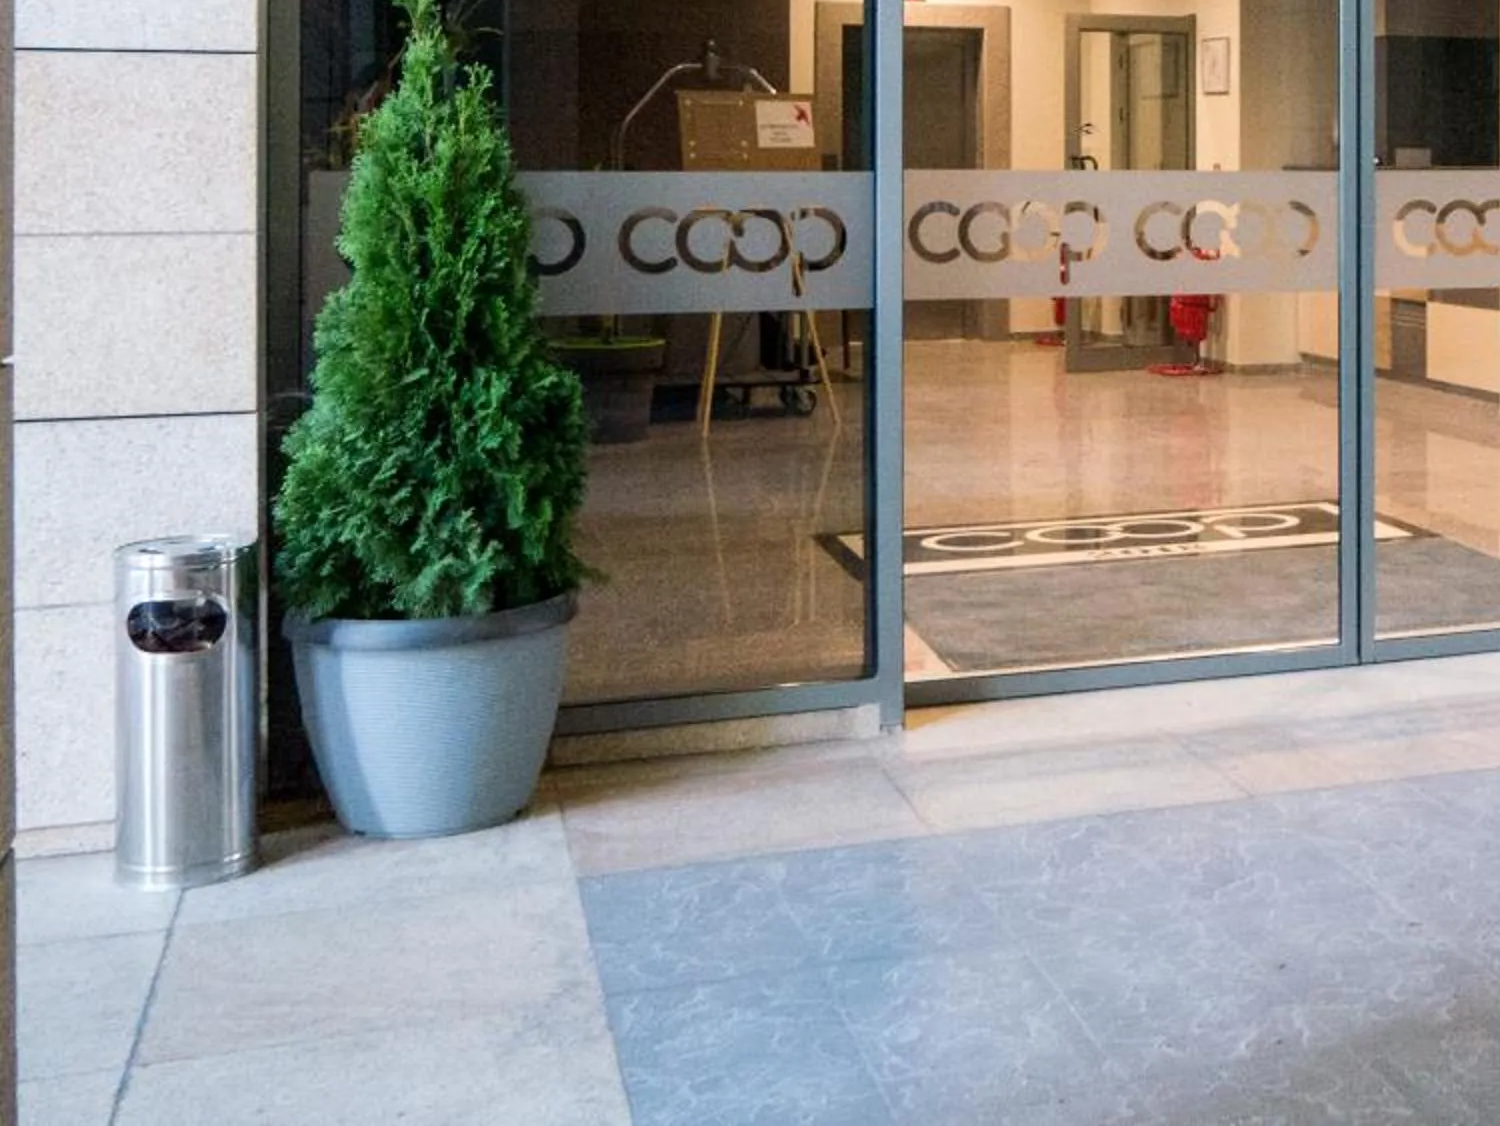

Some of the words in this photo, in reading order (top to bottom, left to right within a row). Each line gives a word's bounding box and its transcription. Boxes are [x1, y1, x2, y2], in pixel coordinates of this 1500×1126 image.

[618, 206, 847, 297] coop
[908, 200, 1109, 285] coop
[921, 513, 1299, 551] coop
